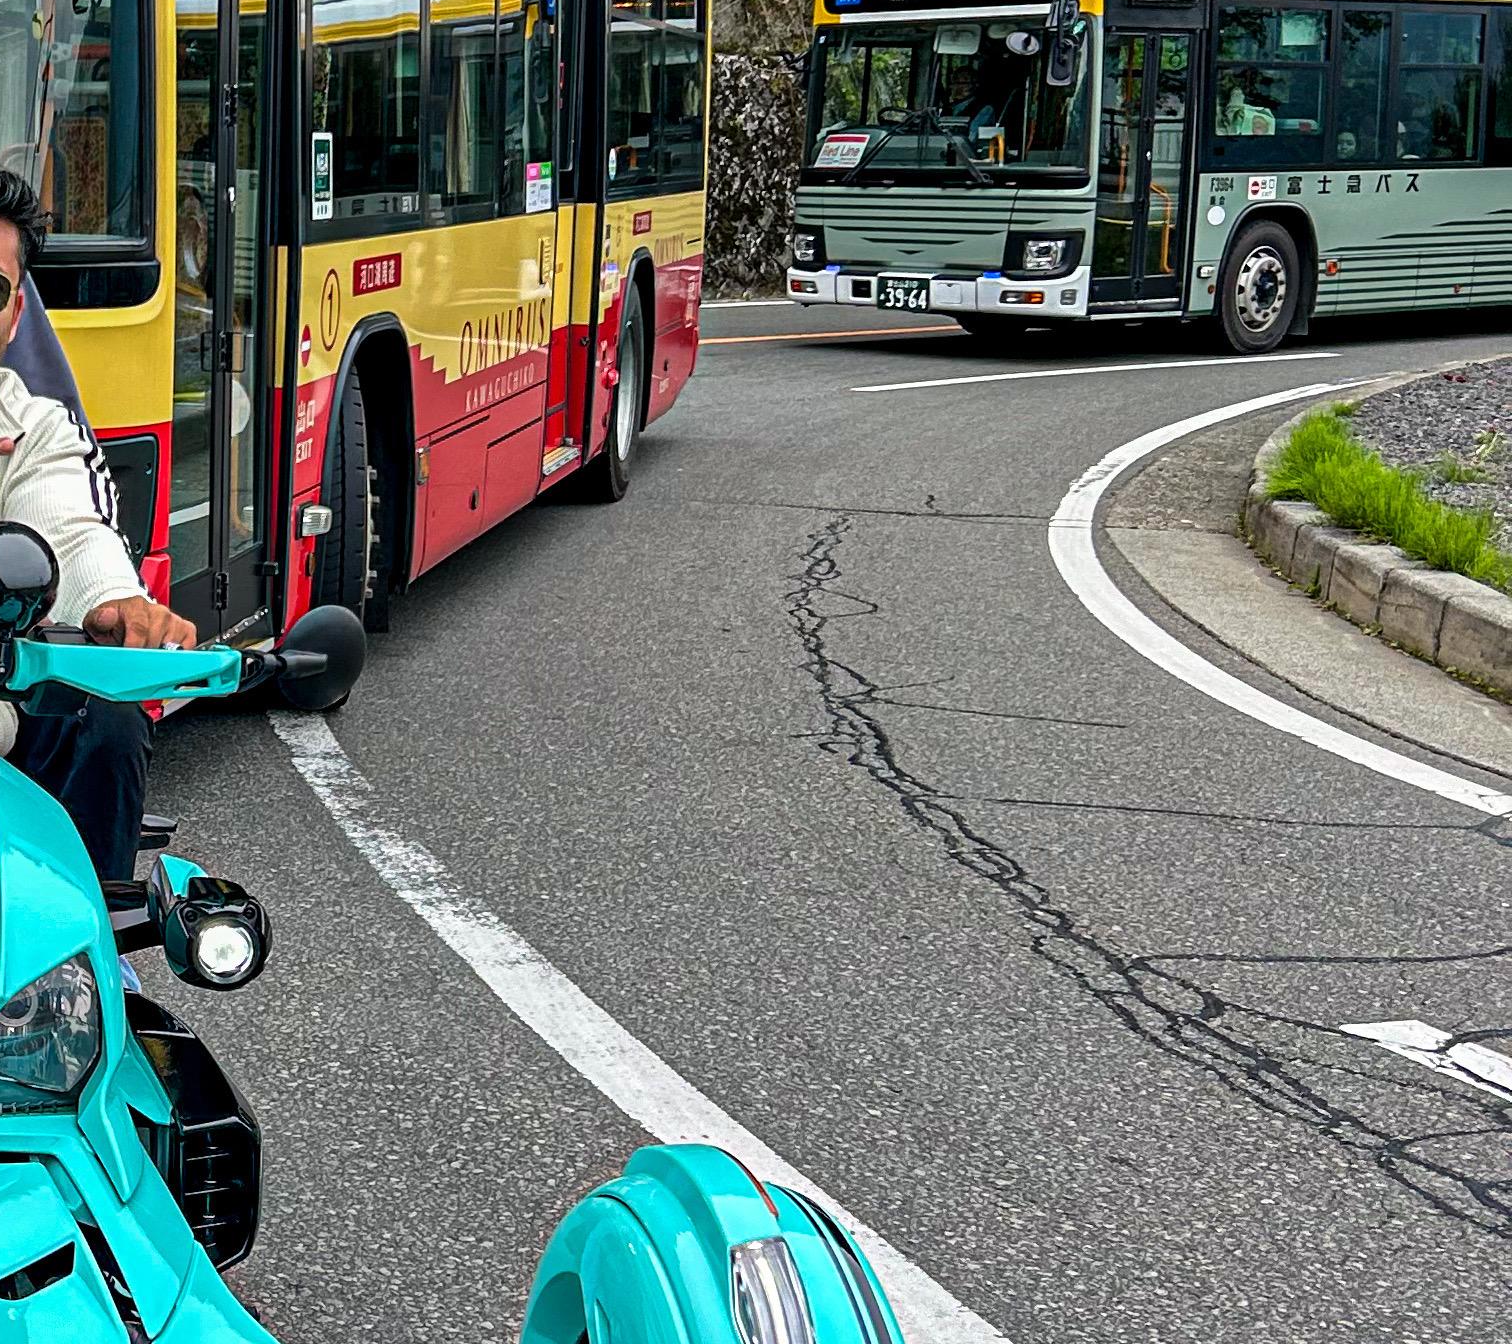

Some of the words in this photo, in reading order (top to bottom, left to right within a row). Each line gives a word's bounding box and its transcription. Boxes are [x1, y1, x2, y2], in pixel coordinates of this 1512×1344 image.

[820, 144, 841, 157] Red
[1286, 174, 1421, 195] 富士急バス
[459, 297, 546, 377] OMNIBUS
